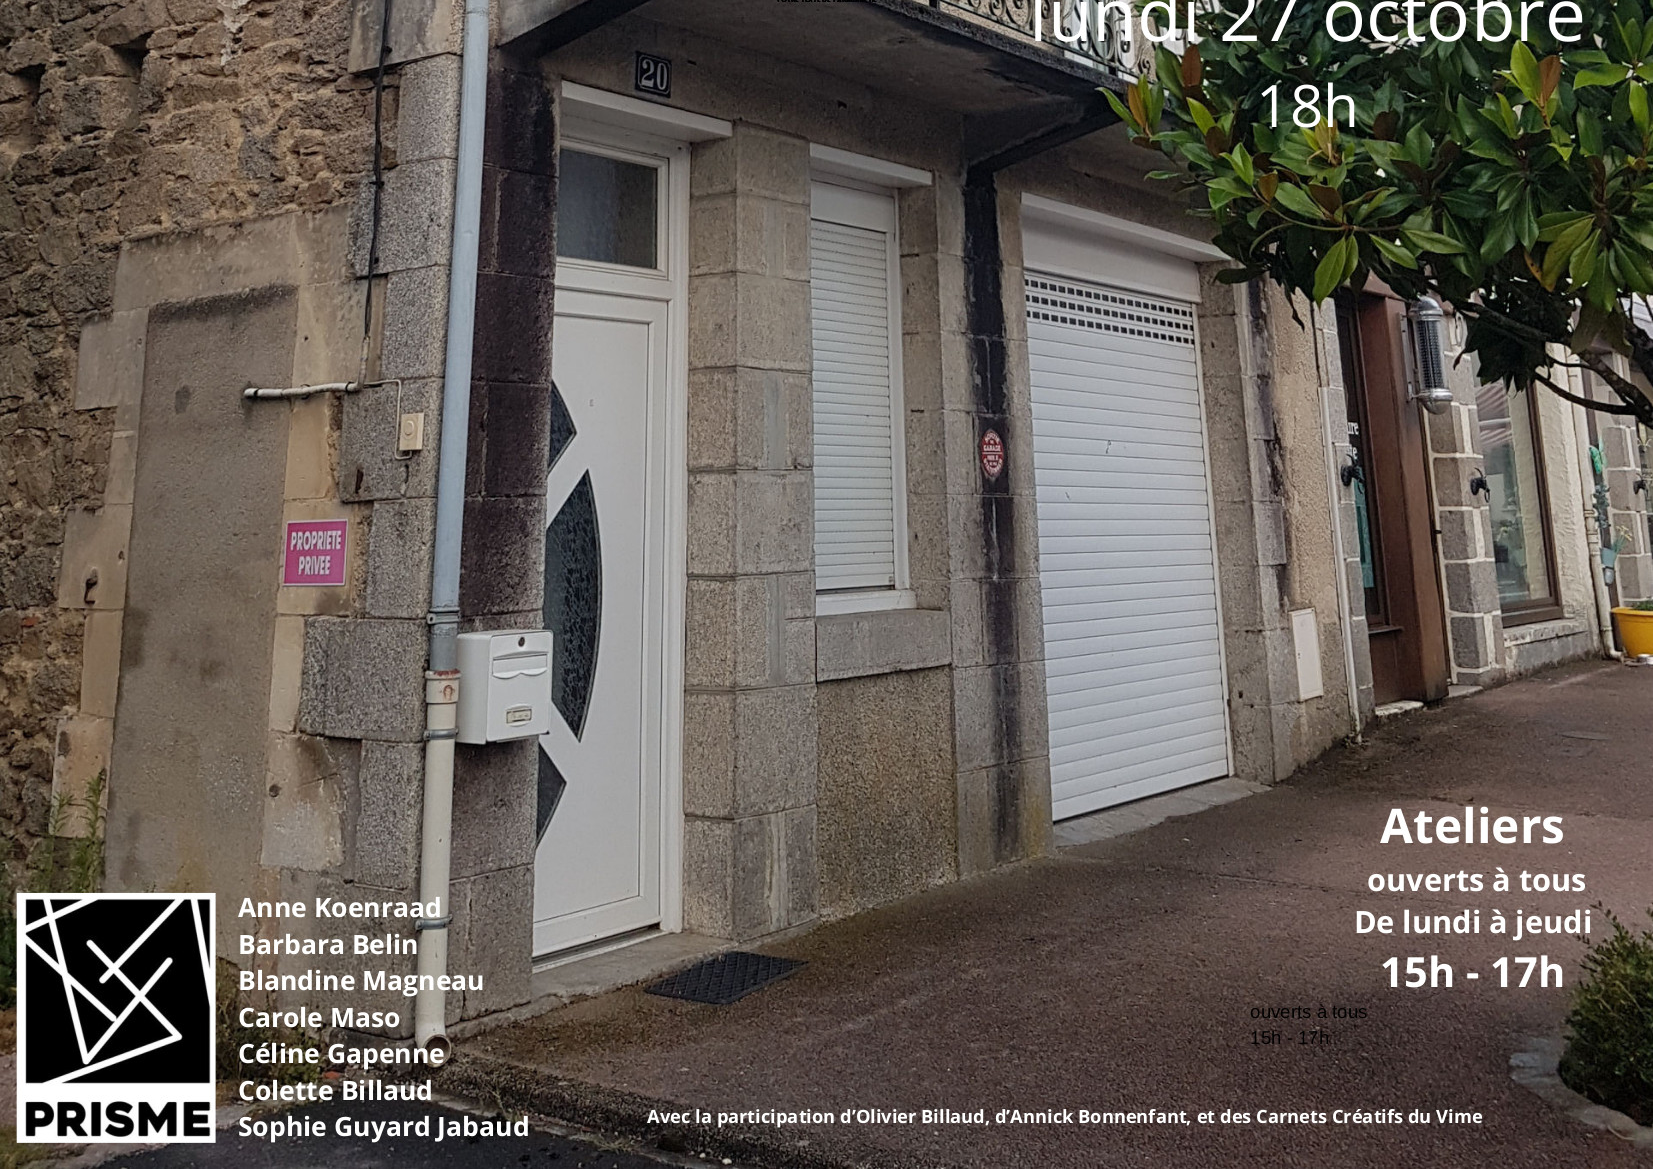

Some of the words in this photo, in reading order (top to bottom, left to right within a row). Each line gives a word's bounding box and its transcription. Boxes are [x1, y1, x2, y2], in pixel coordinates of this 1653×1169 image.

[641, 59, 668, 91] 20
[290, 530, 342, 551] PROPRIETE
[298, 555, 331, 576] PRIVEE
